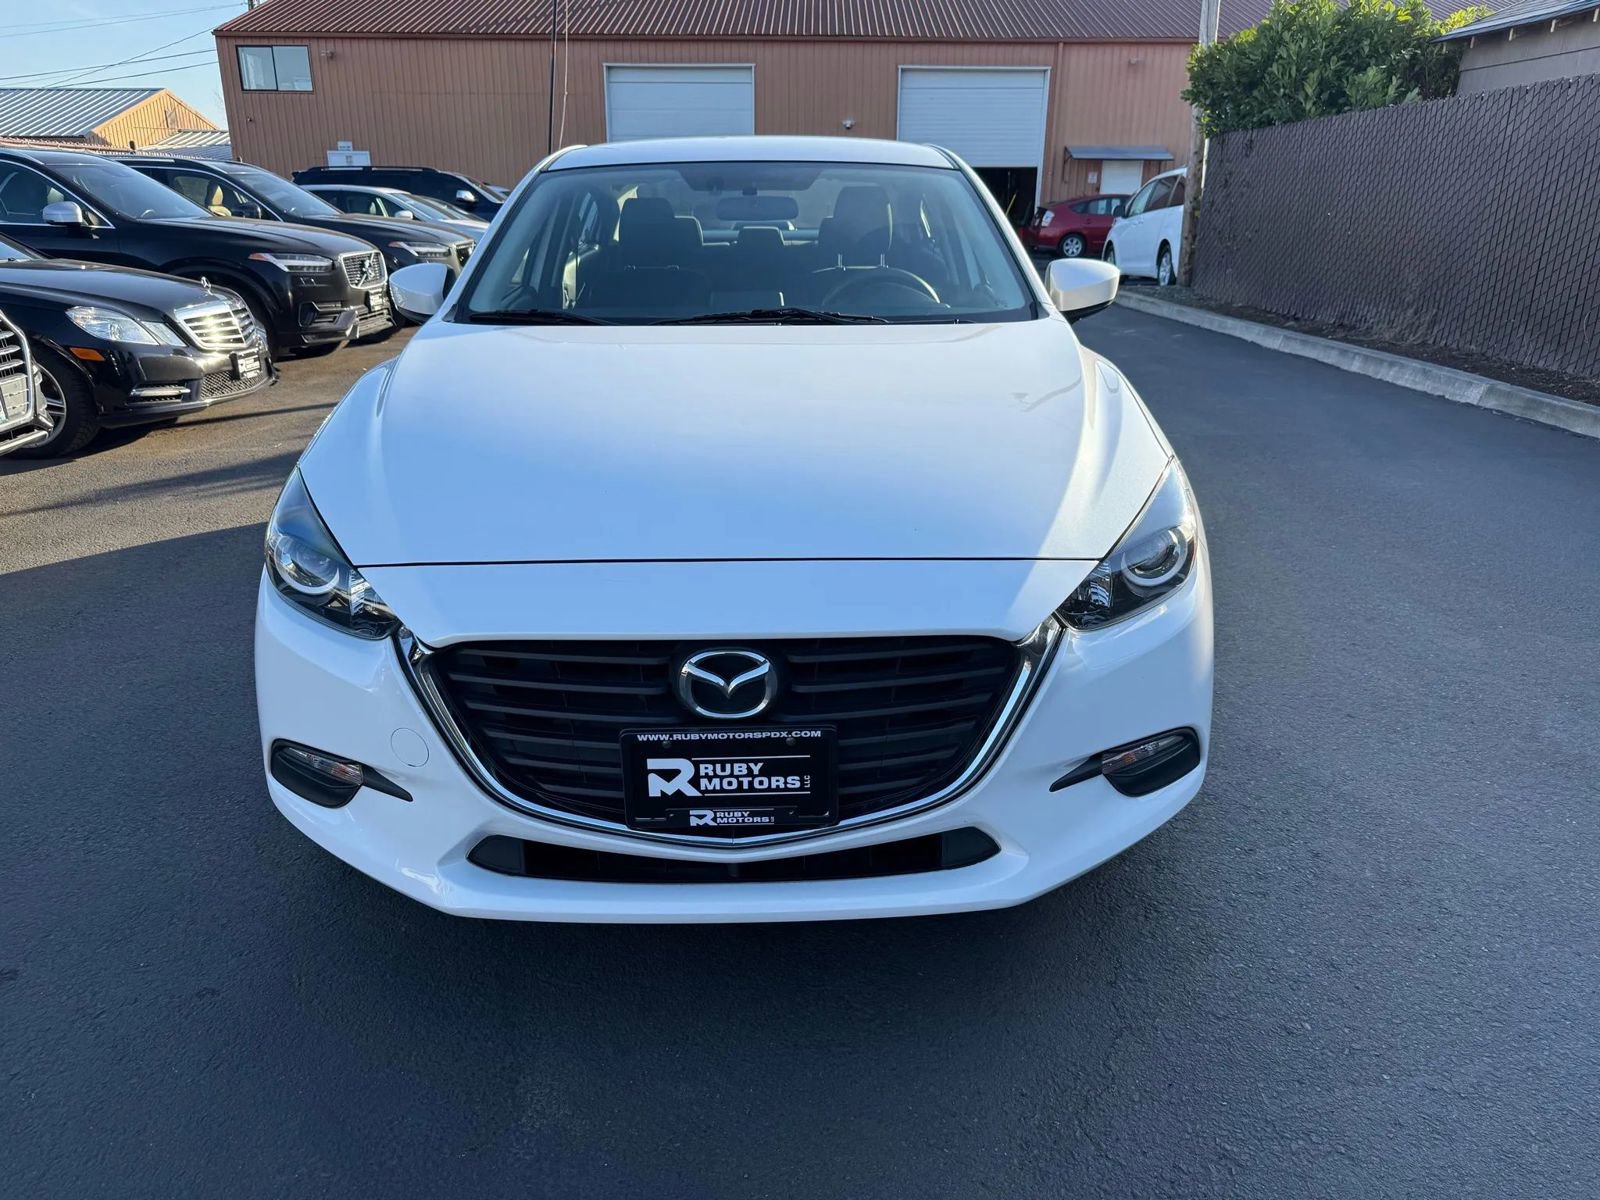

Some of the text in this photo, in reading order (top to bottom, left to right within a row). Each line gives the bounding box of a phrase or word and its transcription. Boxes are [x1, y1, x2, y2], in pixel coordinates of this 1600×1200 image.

[637, 731, 822, 742] WWW.RUBYMOTORSPDX.COM
[699, 762, 764, 776] RUBY
[700, 776, 801, 790] MOTORS
